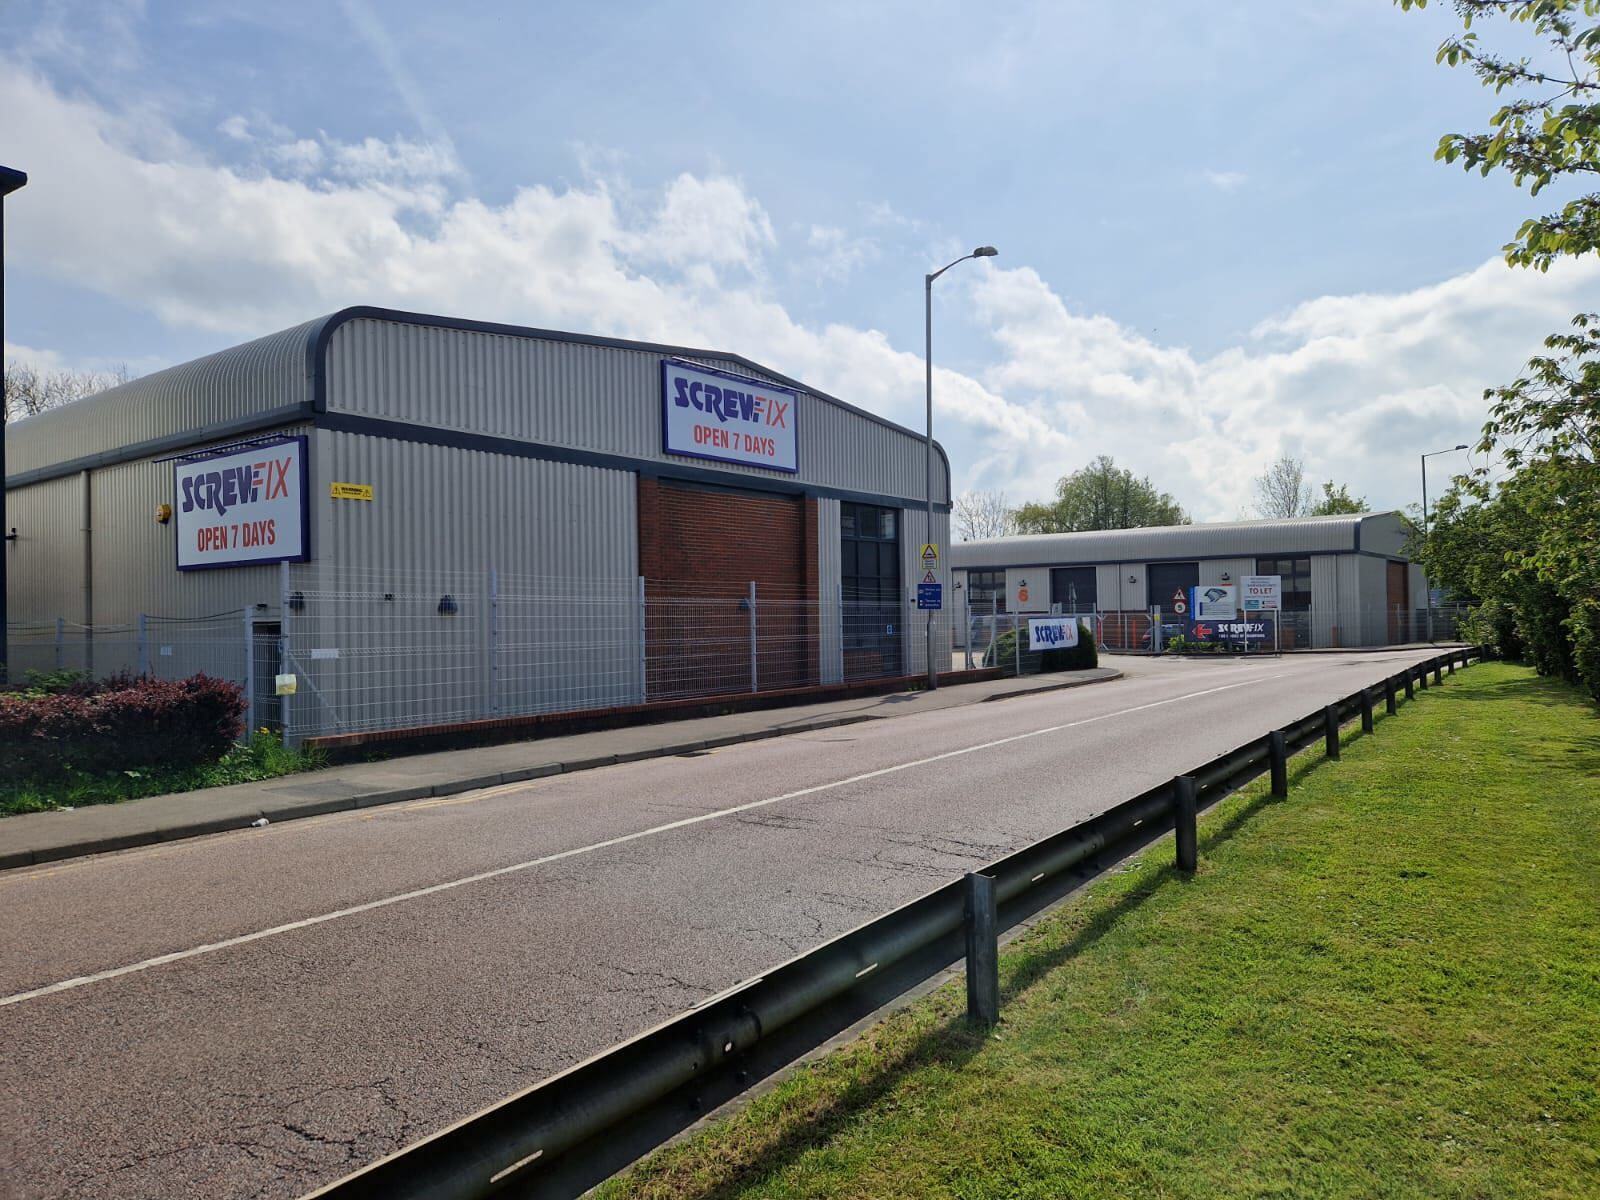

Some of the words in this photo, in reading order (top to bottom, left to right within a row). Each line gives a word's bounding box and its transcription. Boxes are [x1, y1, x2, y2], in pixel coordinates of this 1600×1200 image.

[674, 377, 788, 428] SCREWFIX
[694, 425, 729, 448] OPEN
[733, 433, 740, 450] 7
[745, 434, 775, 456] DAYS
[182, 457, 292, 516] SCREWFIX
[198, 526, 228, 552] OPEN
[231, 525, 239, 548] 7
[243, 519, 276, 547] DAYS
[1034, 624, 1073, 645] SCREWFIX
